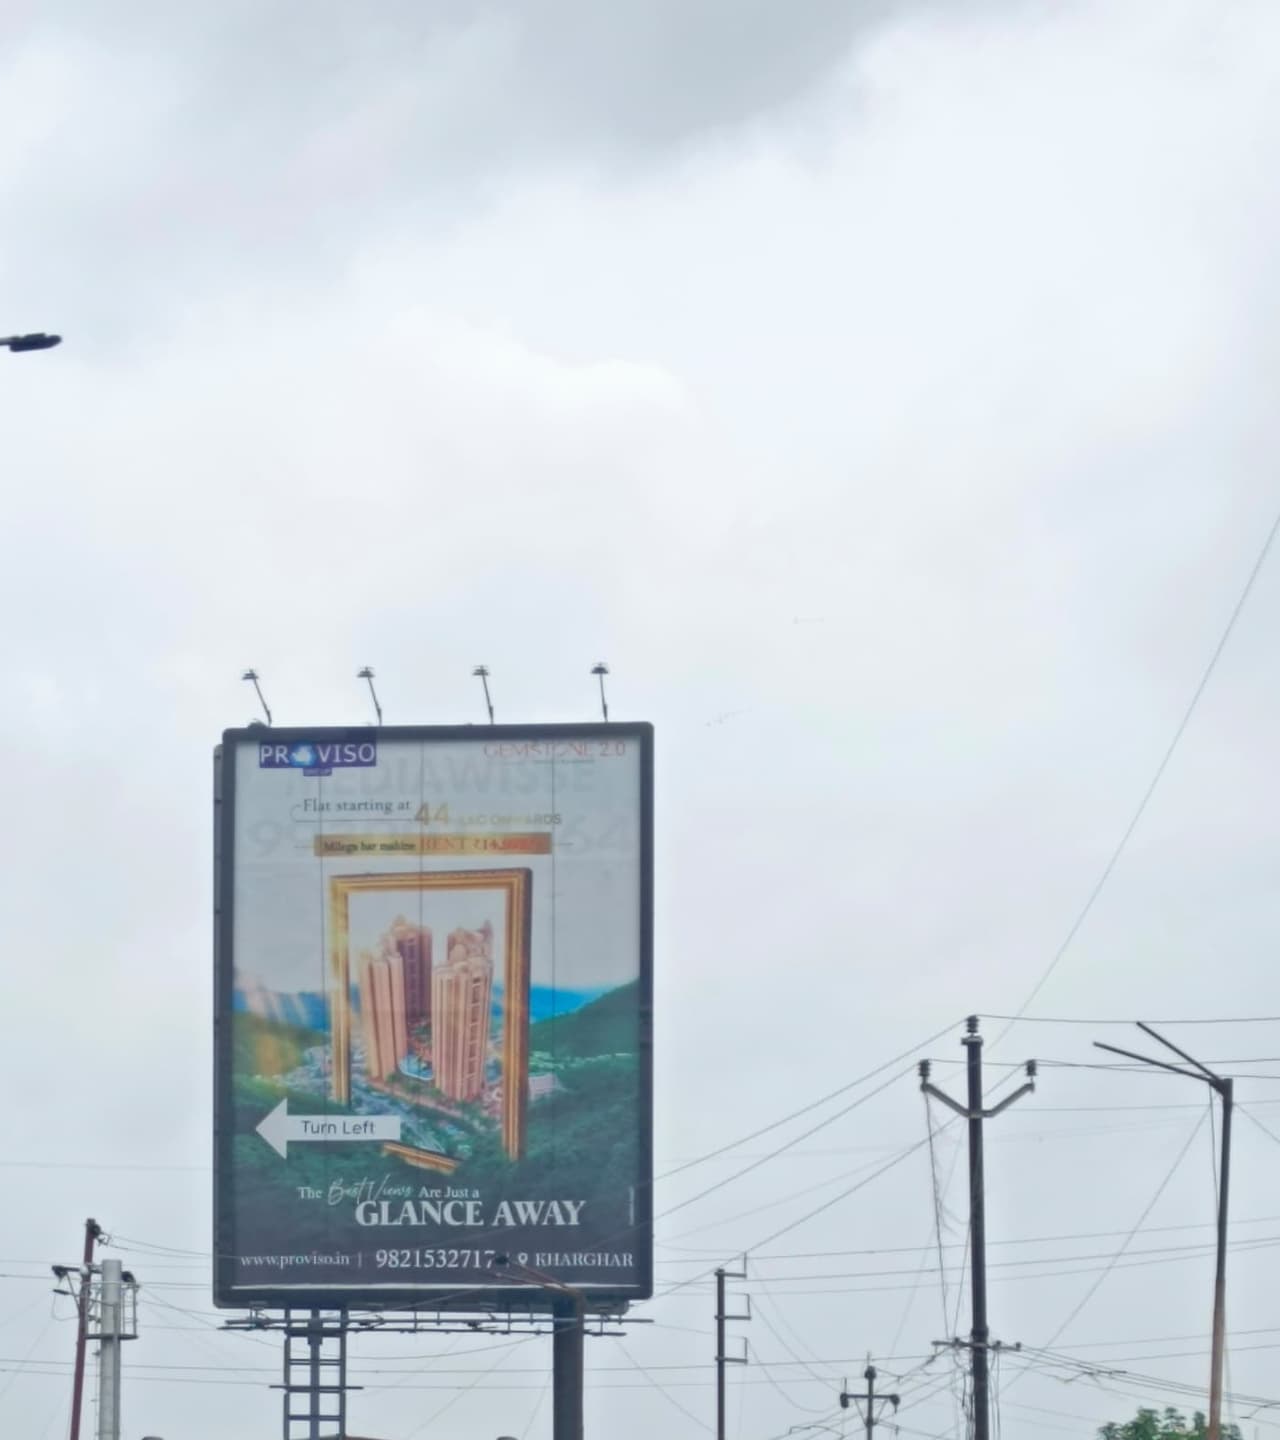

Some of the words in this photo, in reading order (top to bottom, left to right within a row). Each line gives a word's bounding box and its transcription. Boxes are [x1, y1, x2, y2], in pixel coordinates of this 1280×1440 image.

[302, 798, 331, 813] Flat
[336, 799, 393, 815] starting
[397, 801, 411, 812] at
[415, 802, 450, 826] 44
[301, 1120, 337, 1135] Turn
[342, 1120, 375, 1135] Left
[298, 1186, 323, 1199] The
[419, 1186, 441, 1198] Are
[444, 1186, 469, 1199] Just
[472, 1188, 480, 1198] a
[355, 1200, 484, 1227] GLANCE
[492, 1200, 587, 1227] AWAY
[240, 1251, 350, 1269] www.proviso.in
[375, 1249, 496, 1269] 9821532717
[535, 1252, 634, 1267] KHARGHAR
